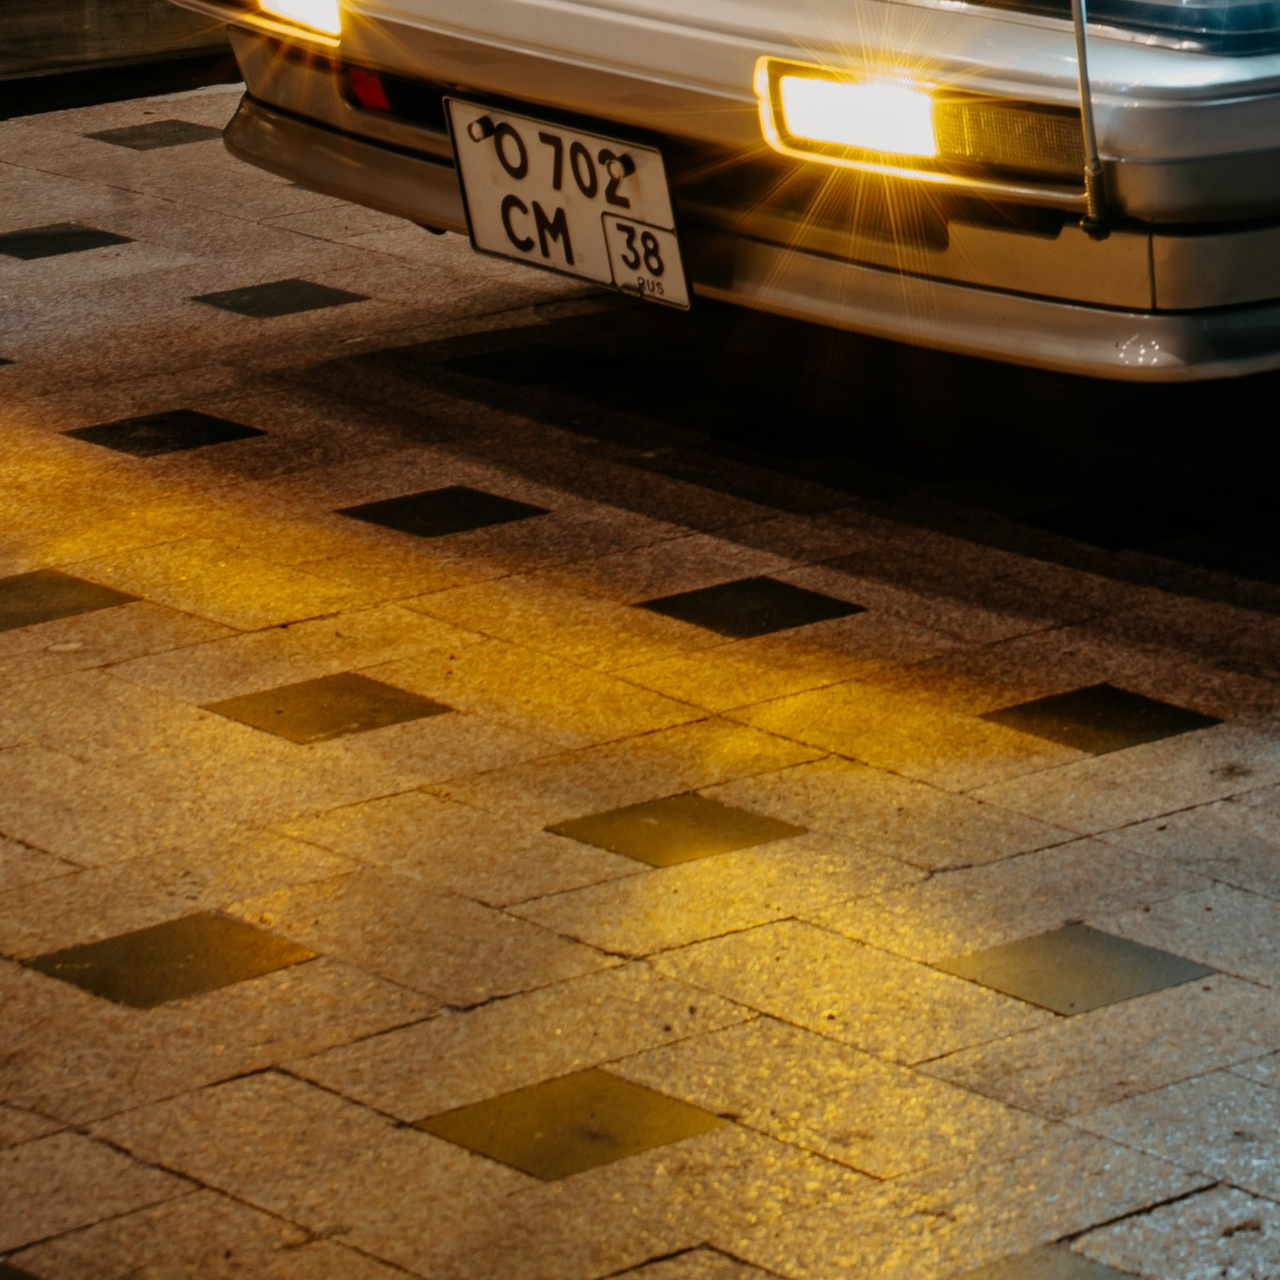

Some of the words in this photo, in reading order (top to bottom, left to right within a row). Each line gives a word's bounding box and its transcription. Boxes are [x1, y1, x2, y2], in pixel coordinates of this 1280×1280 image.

[538, 131, 631, 209] 702
[616, 222, 664, 277] 38
[638, 277, 664, 295] RUS
